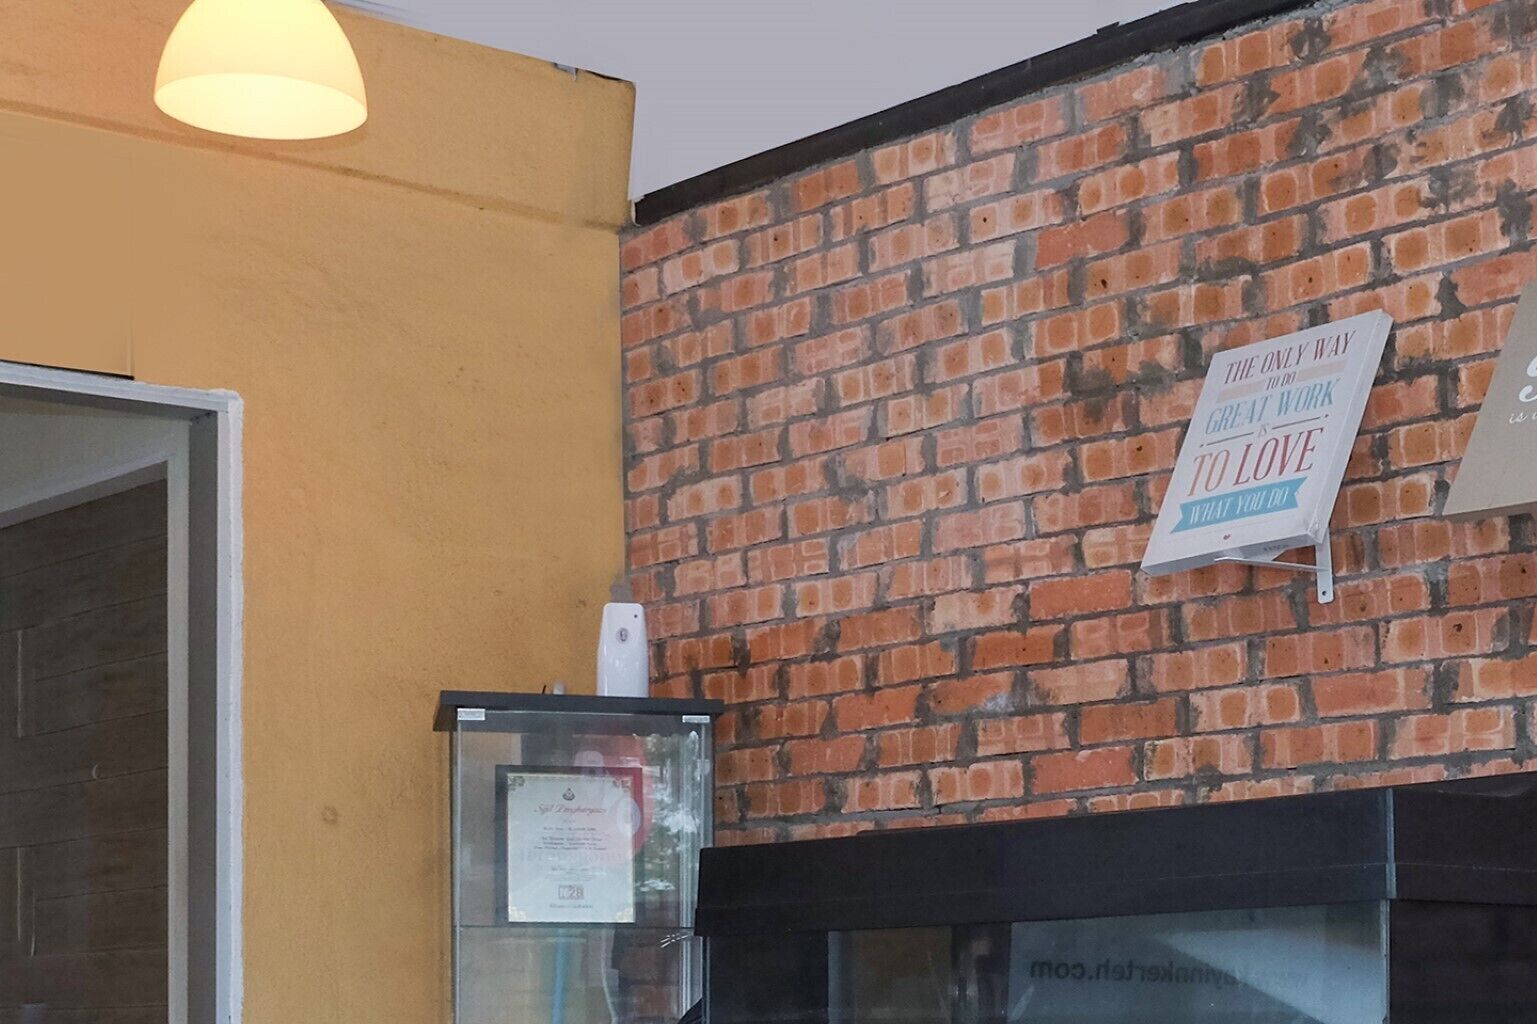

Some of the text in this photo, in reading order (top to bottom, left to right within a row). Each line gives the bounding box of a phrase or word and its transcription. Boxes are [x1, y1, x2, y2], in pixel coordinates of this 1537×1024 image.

[1223, 330, 1356, 385] THE ONLY WAY
[1266, 371, 1297, 390] TO DO
[1205, 378, 1342, 436] GREAT WORK
[1509, 413, 1527, 425] is
[1257, 424, 1270, 438] IS
[1188, 427, 1324, 497] TO LOVE
[1189, 485, 1291, 525] WHAT YOU DO
